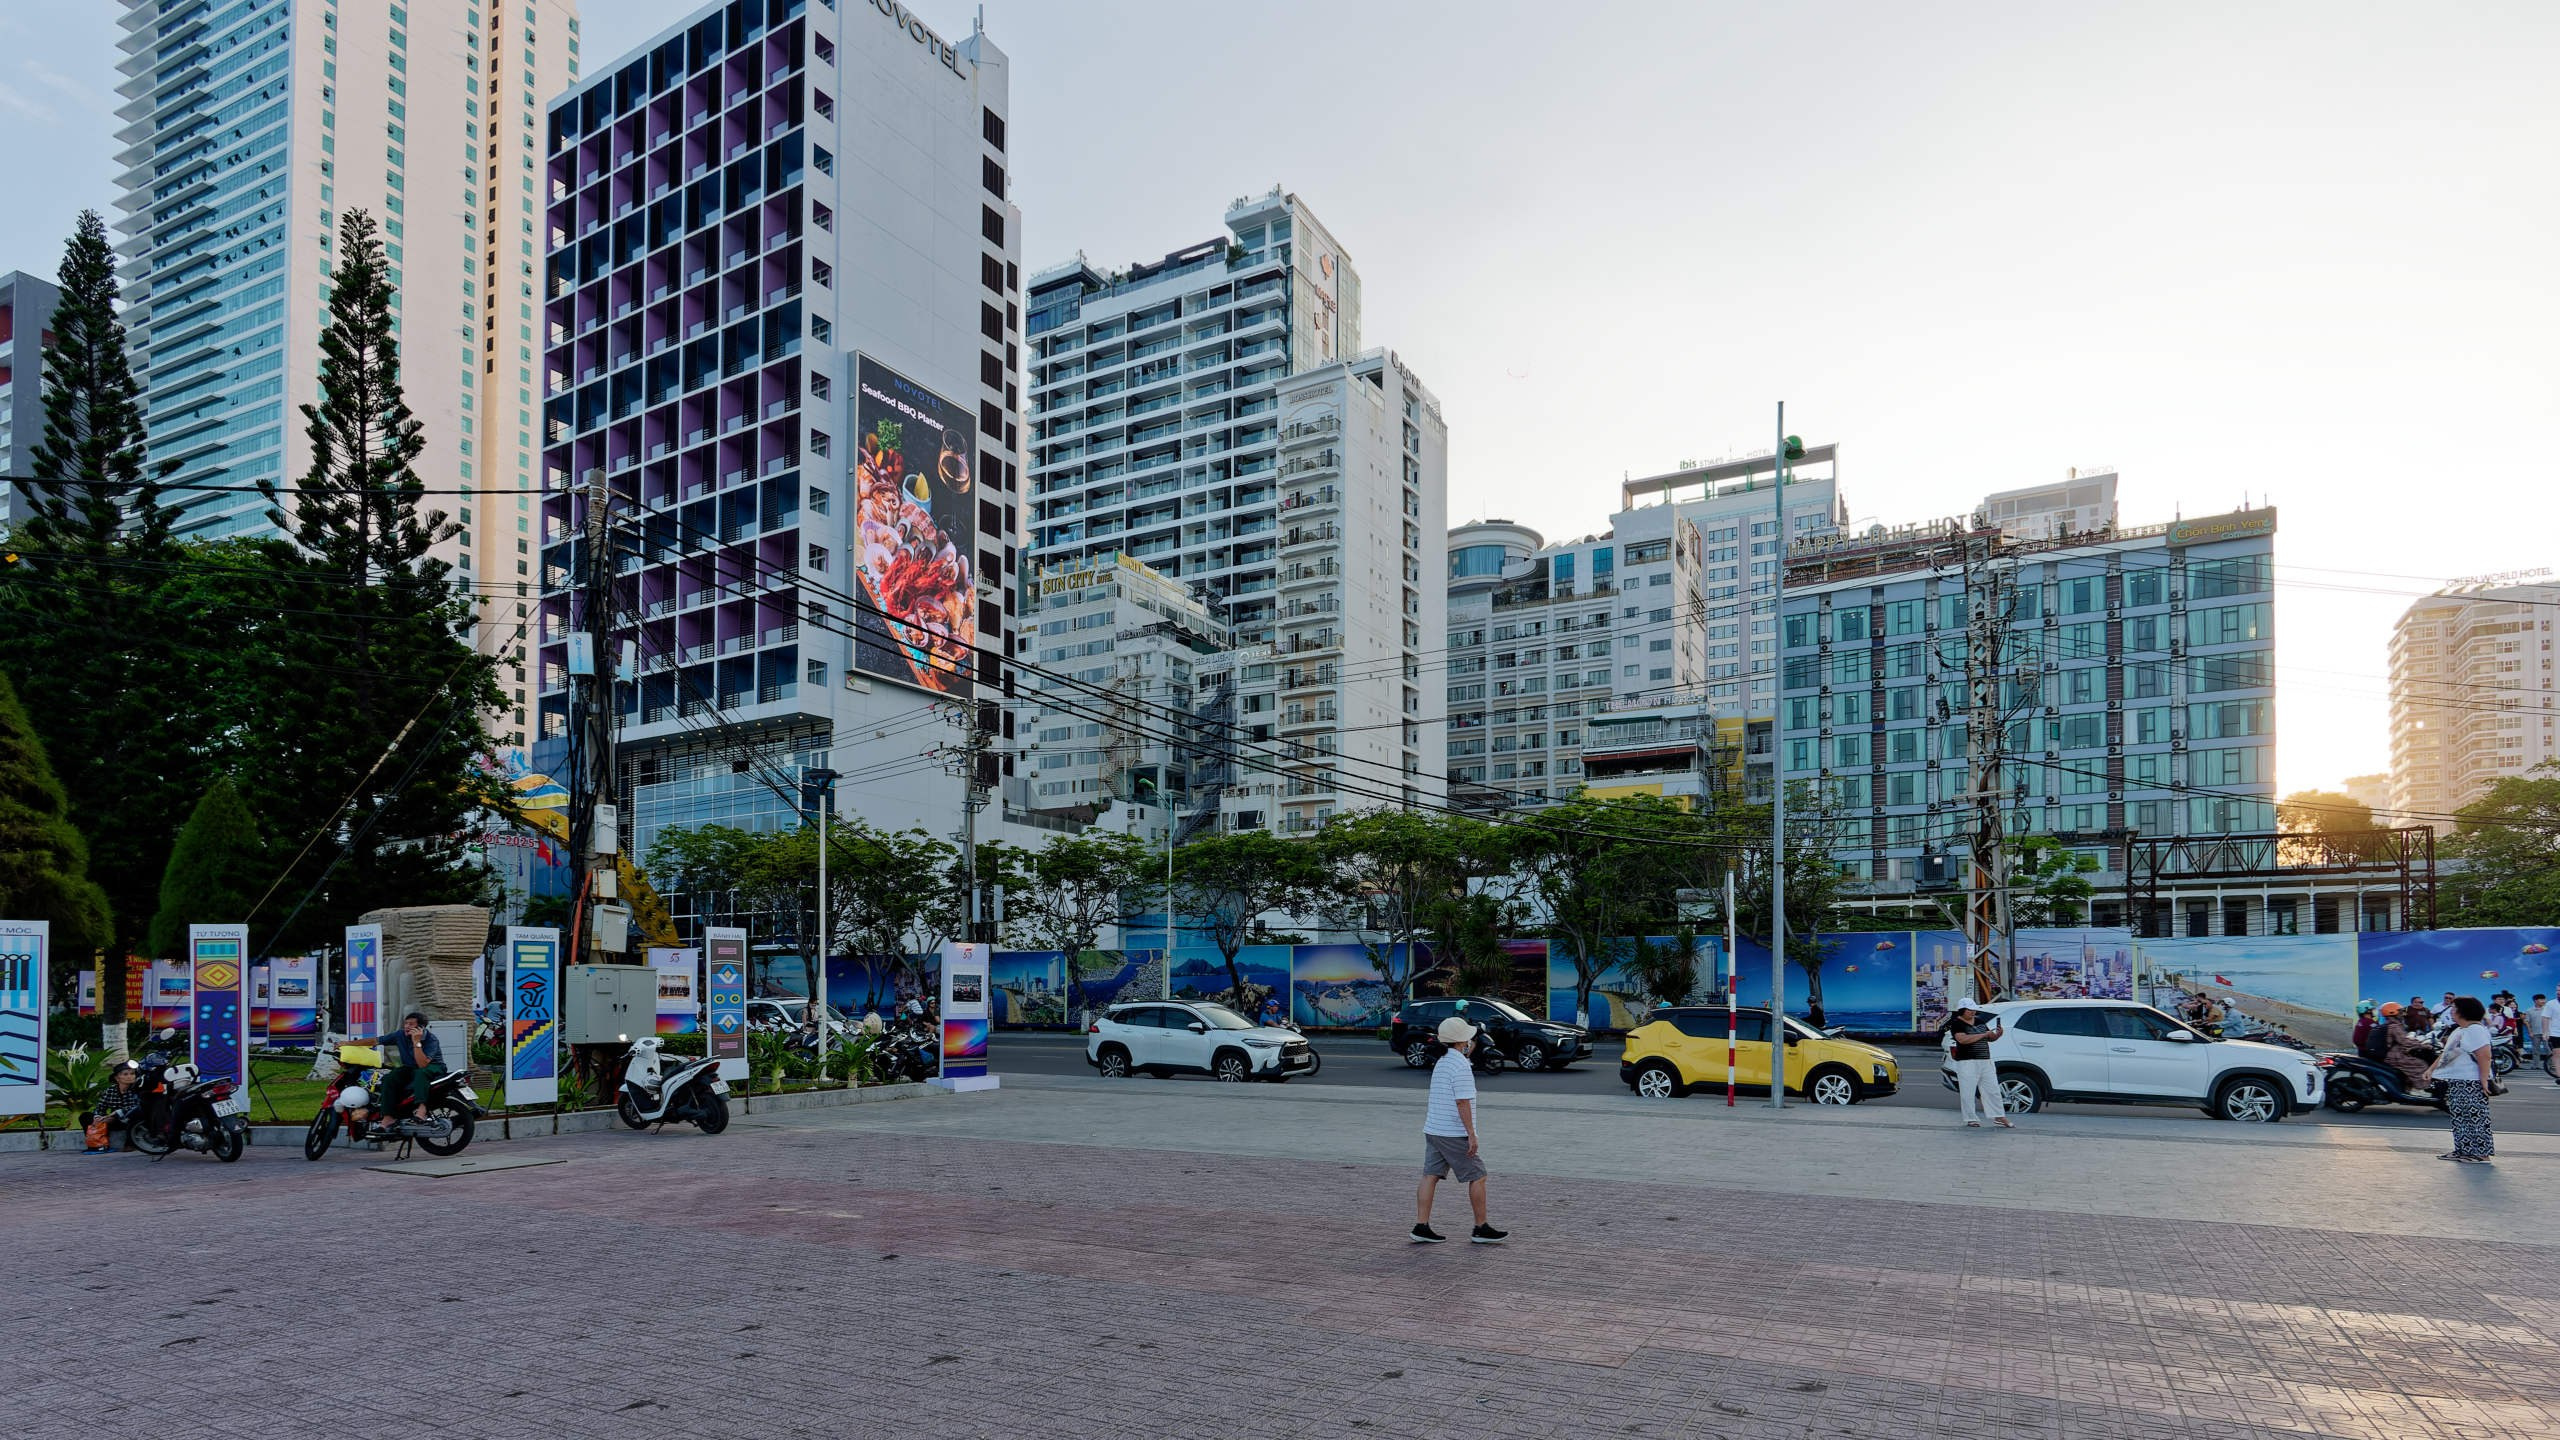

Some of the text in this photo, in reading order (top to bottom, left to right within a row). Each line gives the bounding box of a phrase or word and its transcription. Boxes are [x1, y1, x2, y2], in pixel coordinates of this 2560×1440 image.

[868, 0, 966, 80] OVOTEL
[861, 383, 896, 407] Seafood
[897, 401, 917, 419] BBQ
[917, 411, 944, 431] Platter
[895, 378, 942, 411] NOVOTEL
[1680, 459, 1696, 470] ibis
[1787, 510, 1992, 558] HAPPY LIGHT HOTEL
[1043, 571, 1114, 595] SUN CITY HOTEL
[2519, 567, 2553, 579] HOTEL
[505, 835, 536, 848] 2025
